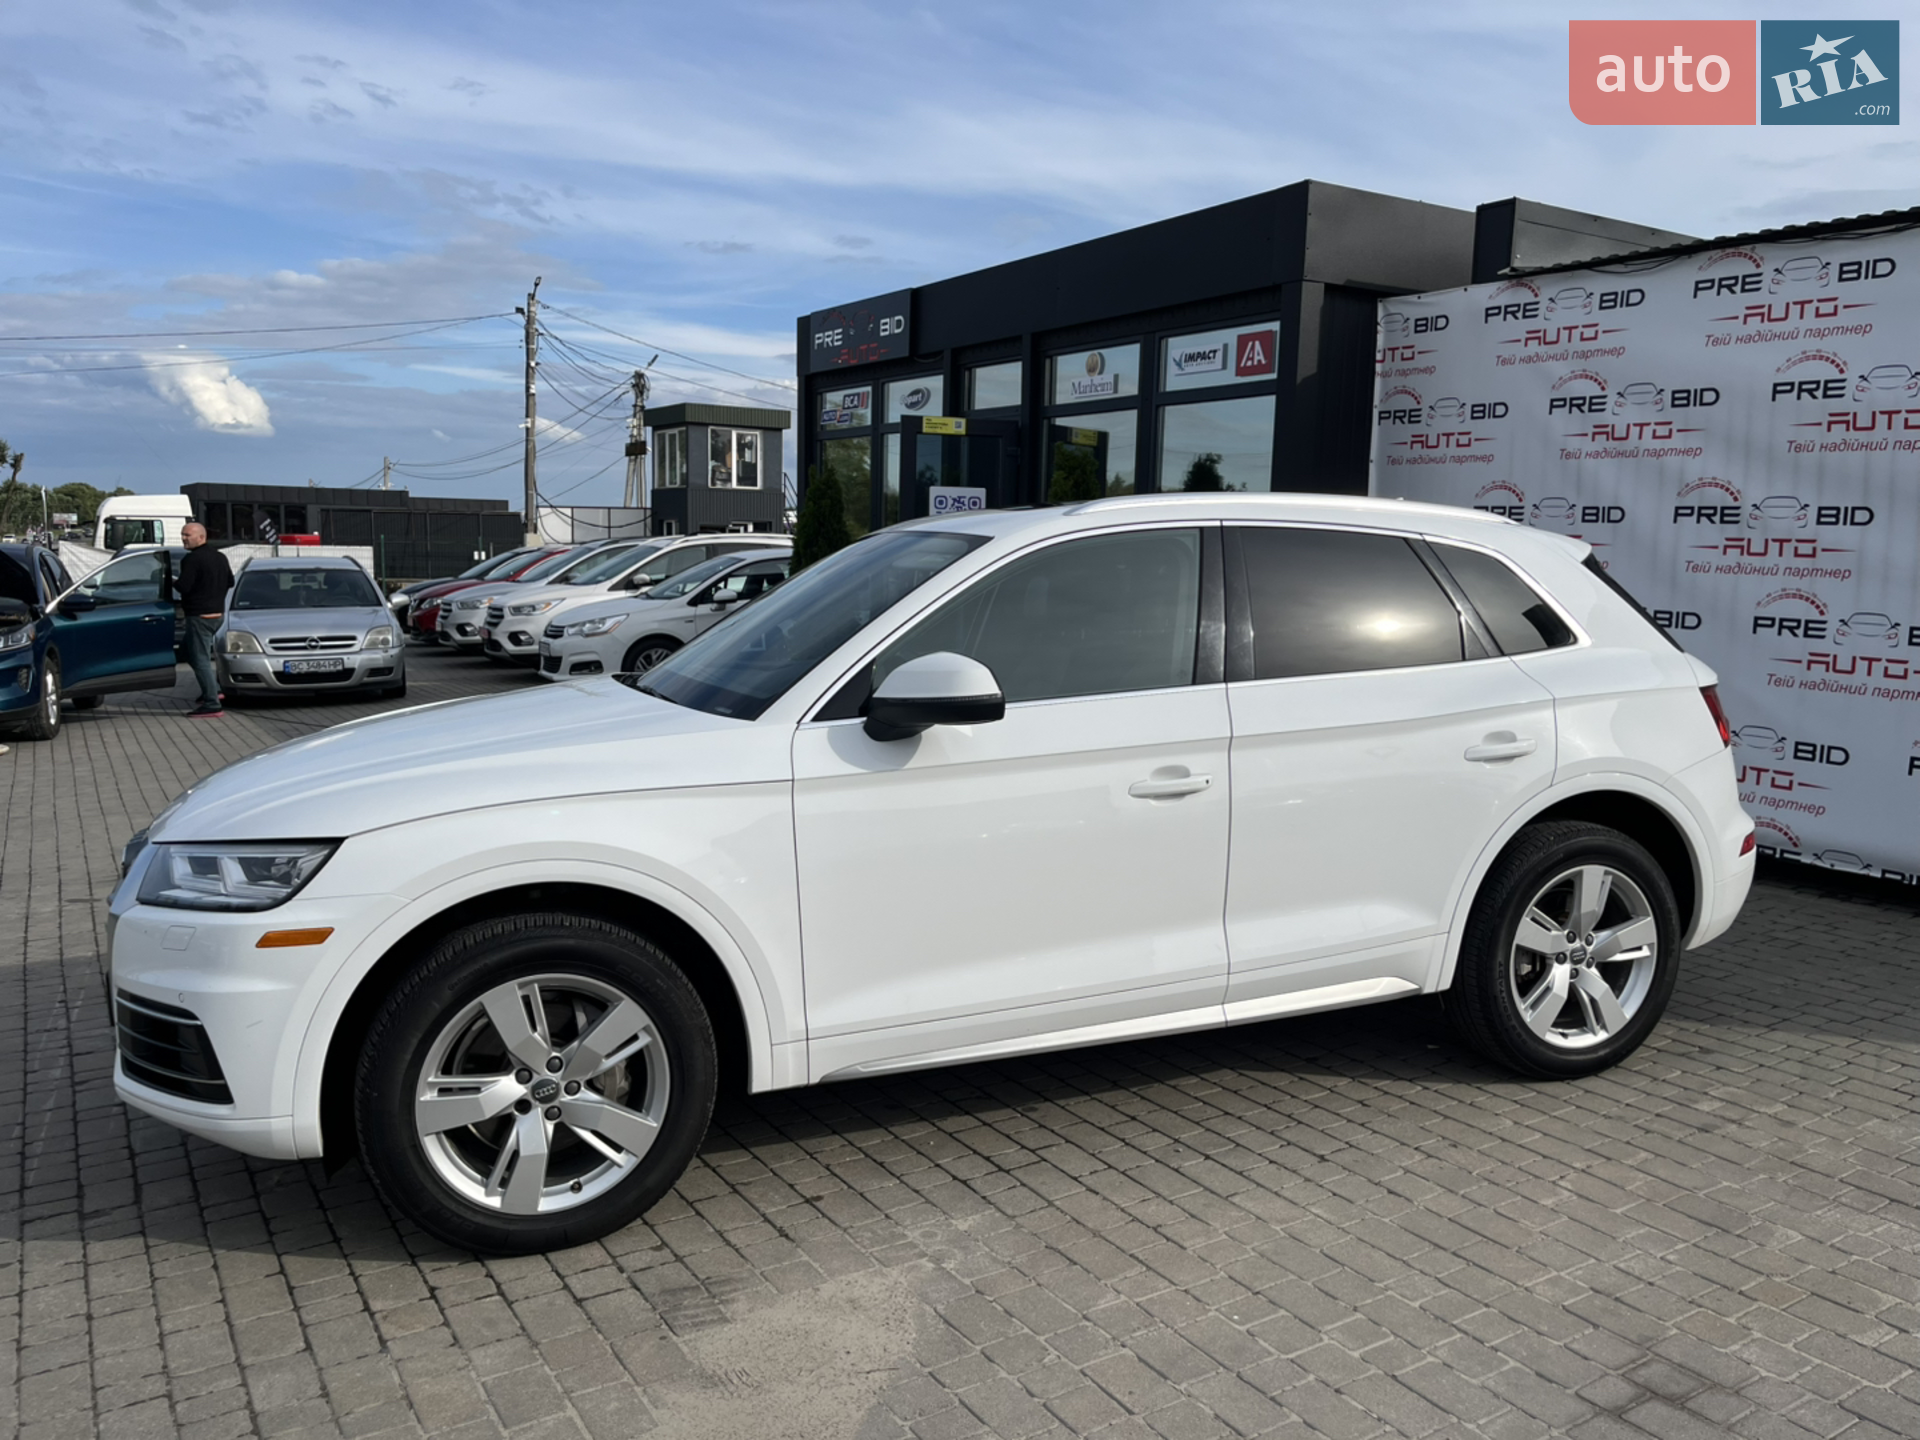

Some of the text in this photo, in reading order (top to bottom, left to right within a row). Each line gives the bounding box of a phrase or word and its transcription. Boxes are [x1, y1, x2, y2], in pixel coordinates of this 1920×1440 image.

[1693, 257, 1897, 299] PRE BID
[1485, 288, 1645, 324] PRE BID
[1742, 296, 1839, 325] AUTO
[814, 315, 905, 350] PRE BID
[1413, 314, 1449, 334] BID
[1524, 323, 1600, 347] AUTO
[1705, 323, 1873, 347] Твій надійний партнер
[1183, 348, 1218, 364] IMPACT
[1376, 345, 1415, 363] UTO
[1495, 344, 1626, 367] Твій надійний партнер
[1071, 376, 1113, 396] Manheim
[1771, 378, 1847, 402] PRE
[844, 395, 859, 408] BCA
[1549, 387, 1720, 415] PRE BID
[1378, 402, 1509, 426] PRE BID
[1410, 431, 1472, 450] AUTO
[1591, 421, 1673, 442] AUTO
[1559, 446, 1703, 460] Твій надійний партнер
[1787, 440, 1815, 453] Твій
[1819, 437, 1888, 452] надійний
[1581, 506, 1625, 523] BID
[1672, 506, 1875, 526] PRE BID
[1722, 537, 1817, 558] AUTO
[1684, 560, 1852, 582] Твій надійний партнер
[1652, 609, 1702, 630] BID
[1752, 616, 1828, 640] PRE
[1806, 652, 1909, 680] AUTO
[1766, 673, 1796, 689] Твій
[1798, 674, 1868, 696] надійний
[1793, 741, 1850, 766] BID
[1758, 794, 1826, 817] партнер
